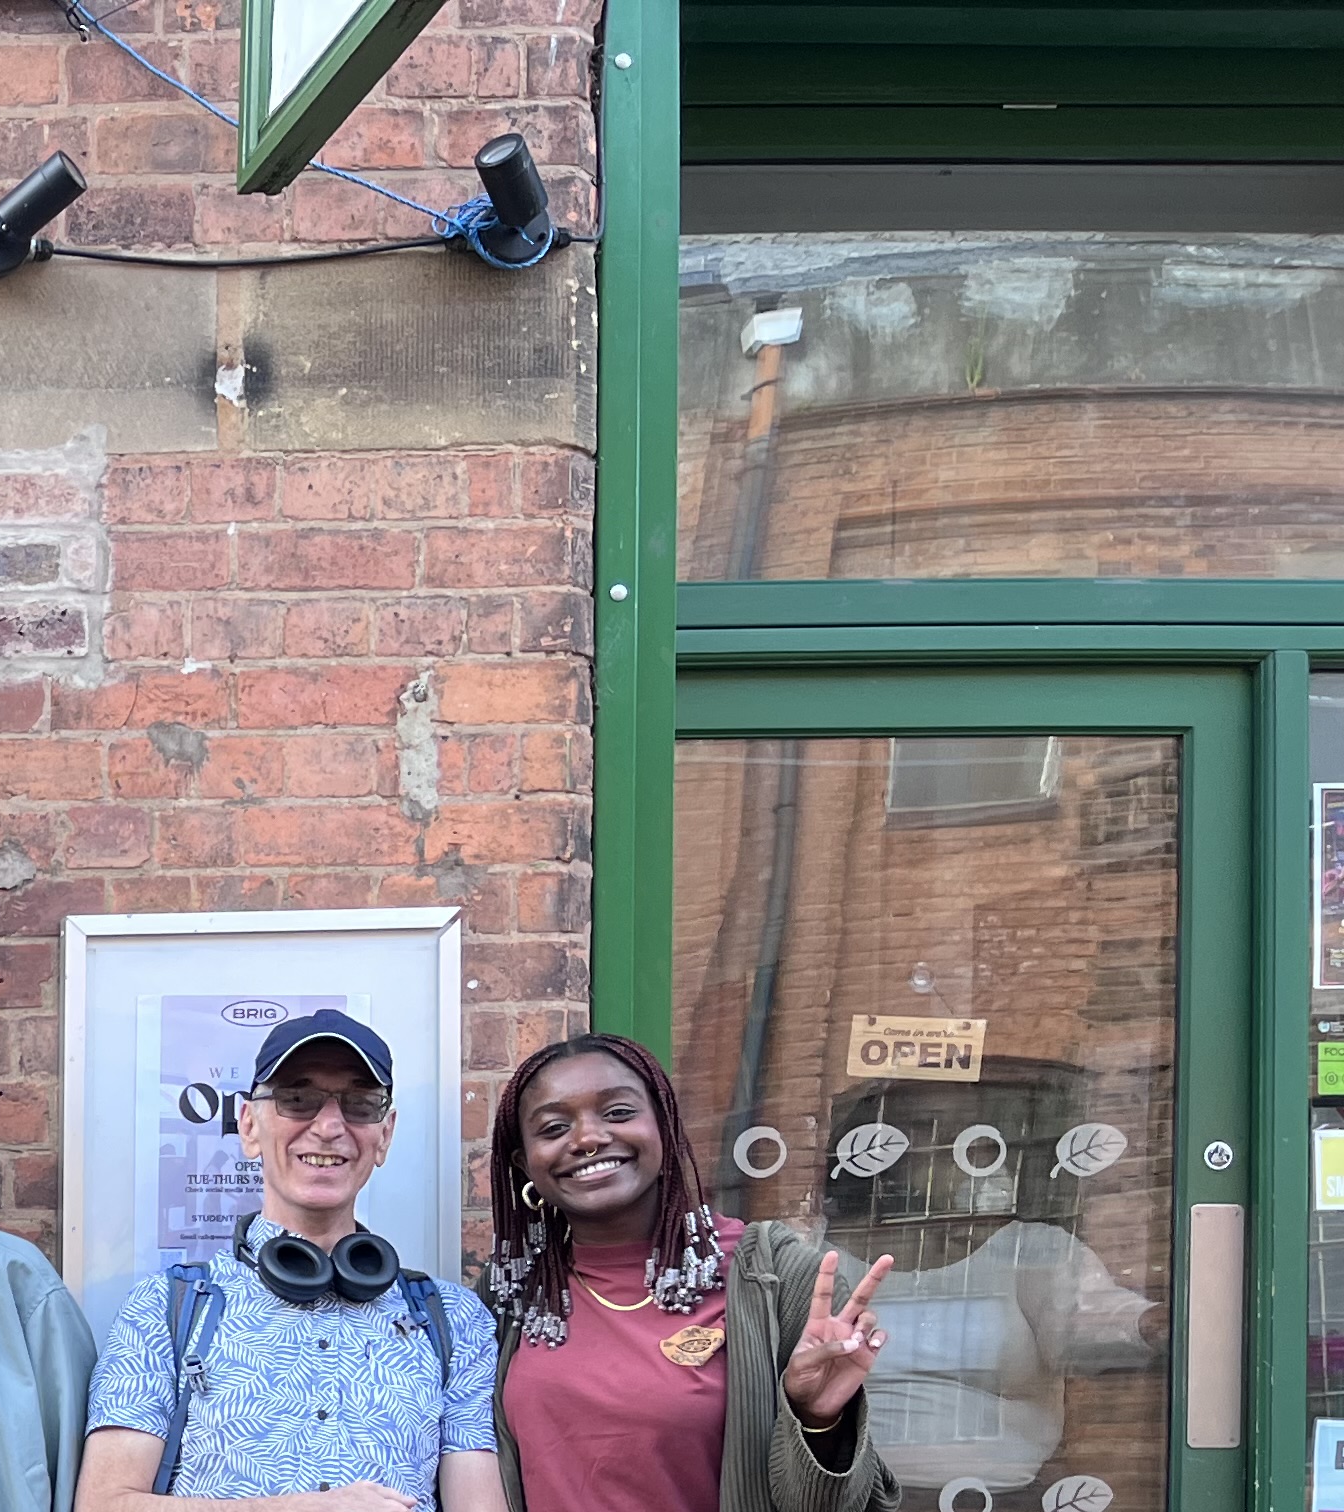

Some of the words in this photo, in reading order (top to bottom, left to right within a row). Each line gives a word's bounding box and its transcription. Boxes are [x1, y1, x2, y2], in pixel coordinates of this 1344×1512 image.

[233, 1008, 277, 1019] BRIG
[860, 1039, 973, 1069] OPEN
[187, 1174, 250, 1185] TUE-THURS
[192, 1214, 234, 1222] STUDENT
